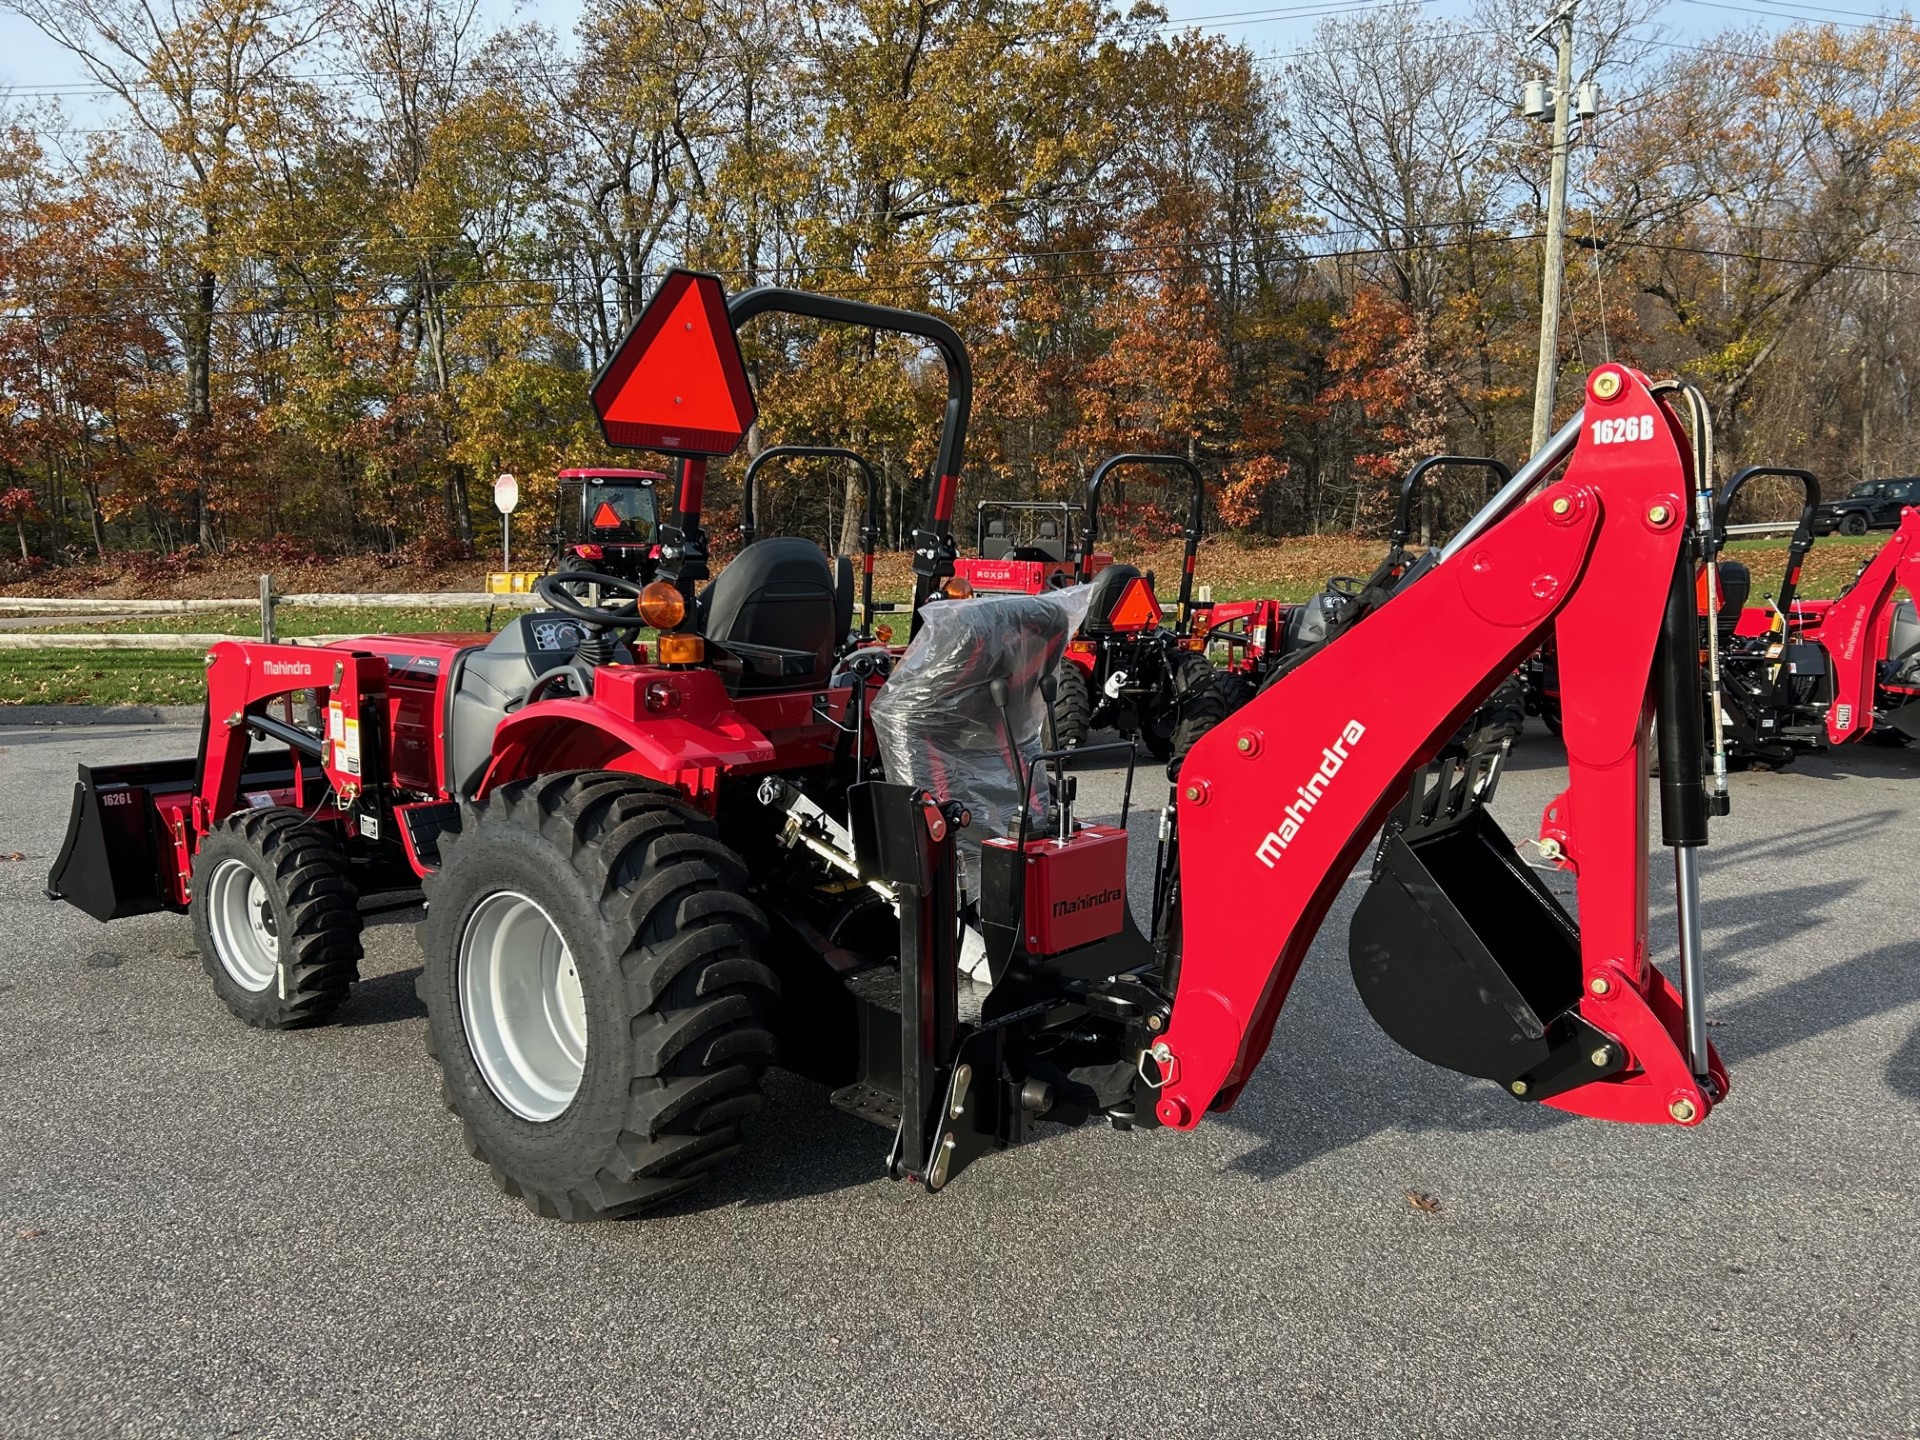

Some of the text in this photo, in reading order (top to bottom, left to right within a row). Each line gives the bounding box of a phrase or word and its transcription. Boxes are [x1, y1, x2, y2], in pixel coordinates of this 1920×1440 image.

[976, 571, 1010, 579] ROXOR
[263, 661, 311, 675] Mahindra
[417, 658, 438, 667] 1626
[1255, 719, 1366, 869] Mahindra
[1053, 888, 1121, 918] Mahindra
